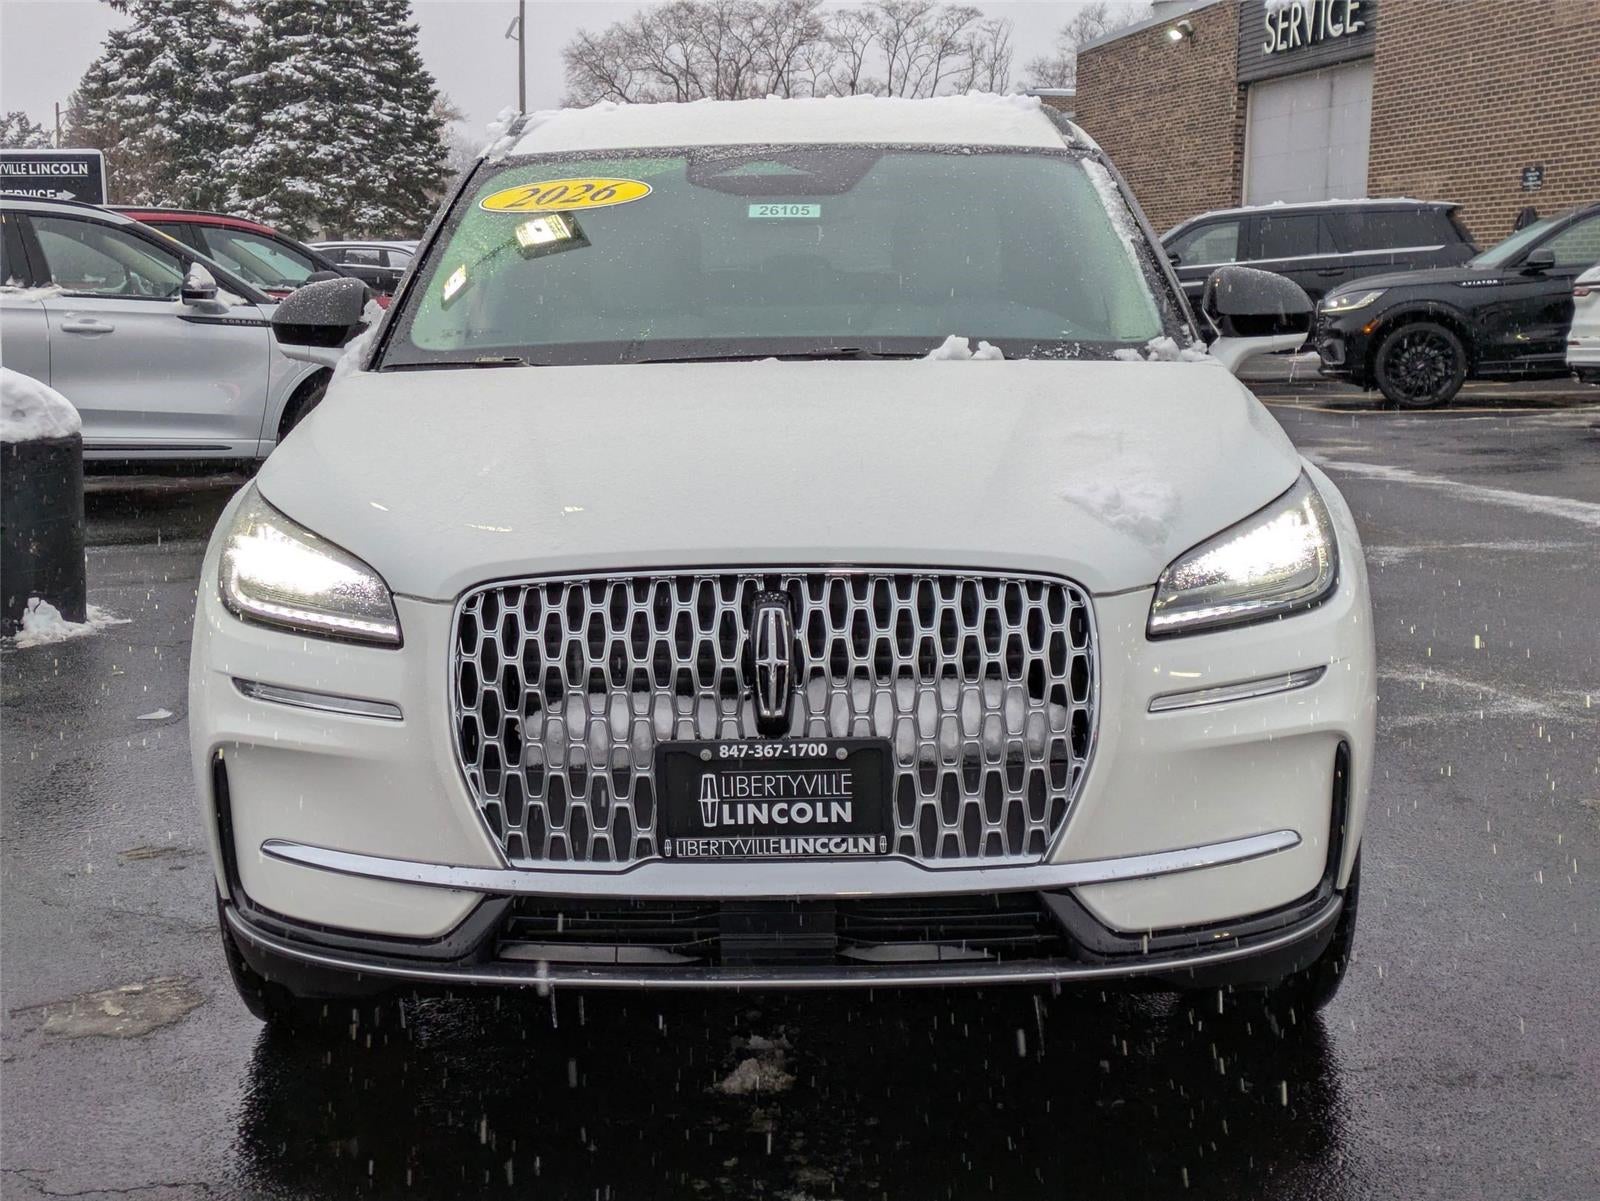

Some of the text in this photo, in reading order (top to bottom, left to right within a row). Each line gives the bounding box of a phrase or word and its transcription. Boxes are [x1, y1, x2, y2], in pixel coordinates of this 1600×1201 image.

[1263, 0, 1361, 54] SERVICE
[29, 163, 88, 174] LINCOLN
[0, 189, 56, 199] RVICE
[503, 182, 628, 209] 2026
[759, 205, 810, 216] 26105
[1461, 279, 1499, 287] AVIATOR
[719, 743, 828, 758] 847-367-1700
[721, 773, 852, 798] LIBERTYVILLE
[722, 802, 852, 825] LINCOLN
